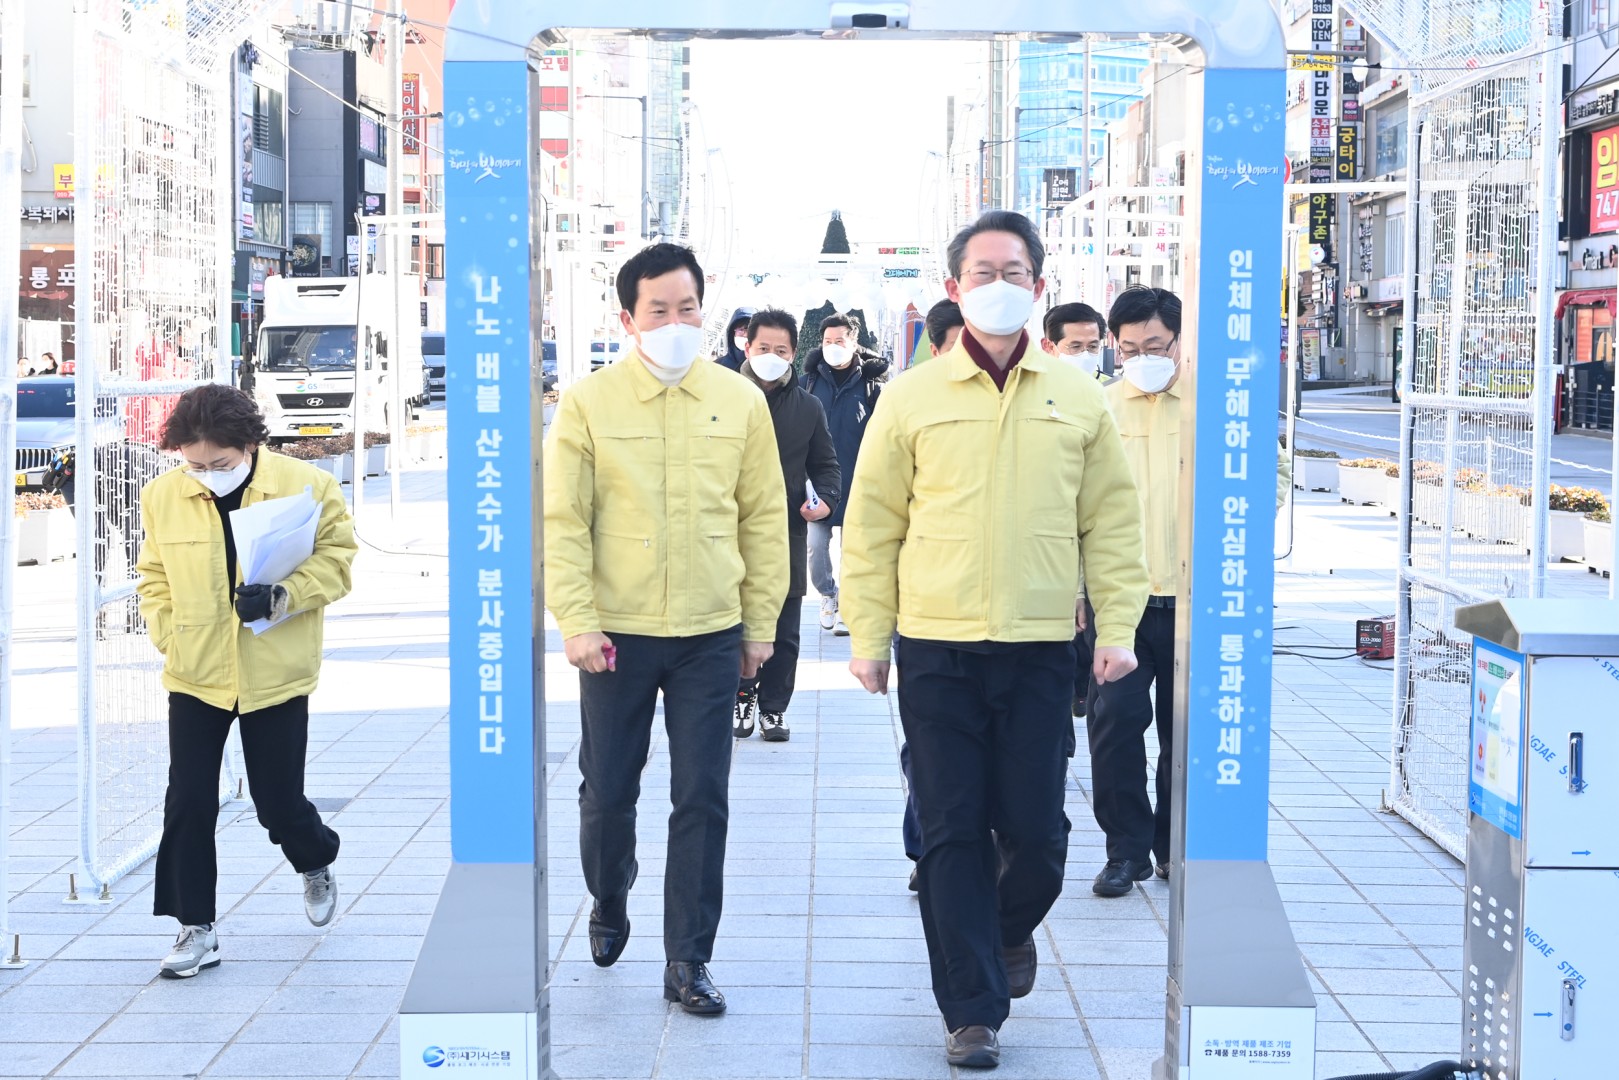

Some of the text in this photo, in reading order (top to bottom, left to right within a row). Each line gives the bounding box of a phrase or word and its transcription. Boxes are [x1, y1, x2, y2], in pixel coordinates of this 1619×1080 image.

[1313, 4, 1331, 13] 3153
[1312, 19, 1331, 29] TOP
[1312, 30, 1331, 40] TEN
[1339, 127, 1356, 178] 궁타이
[1312, 194, 1328, 240] 야구존
[474, 275, 506, 755] 나노 버블 산소수가 분사중입니다
[1216, 249, 1253, 785] 인체에 무해하니 안심하고 통과하세요
[1531, 734, 1556, 763] GJAE
[1557, 960, 1588, 990] STEEL
[1214, 1049, 1291, 1058] 제품 문의 1588-7359
[1241, 1039, 1257, 1049] 제품
[1259, 1040, 1274, 1048] 제조
[1276, 1040, 1291, 1049] 기업
